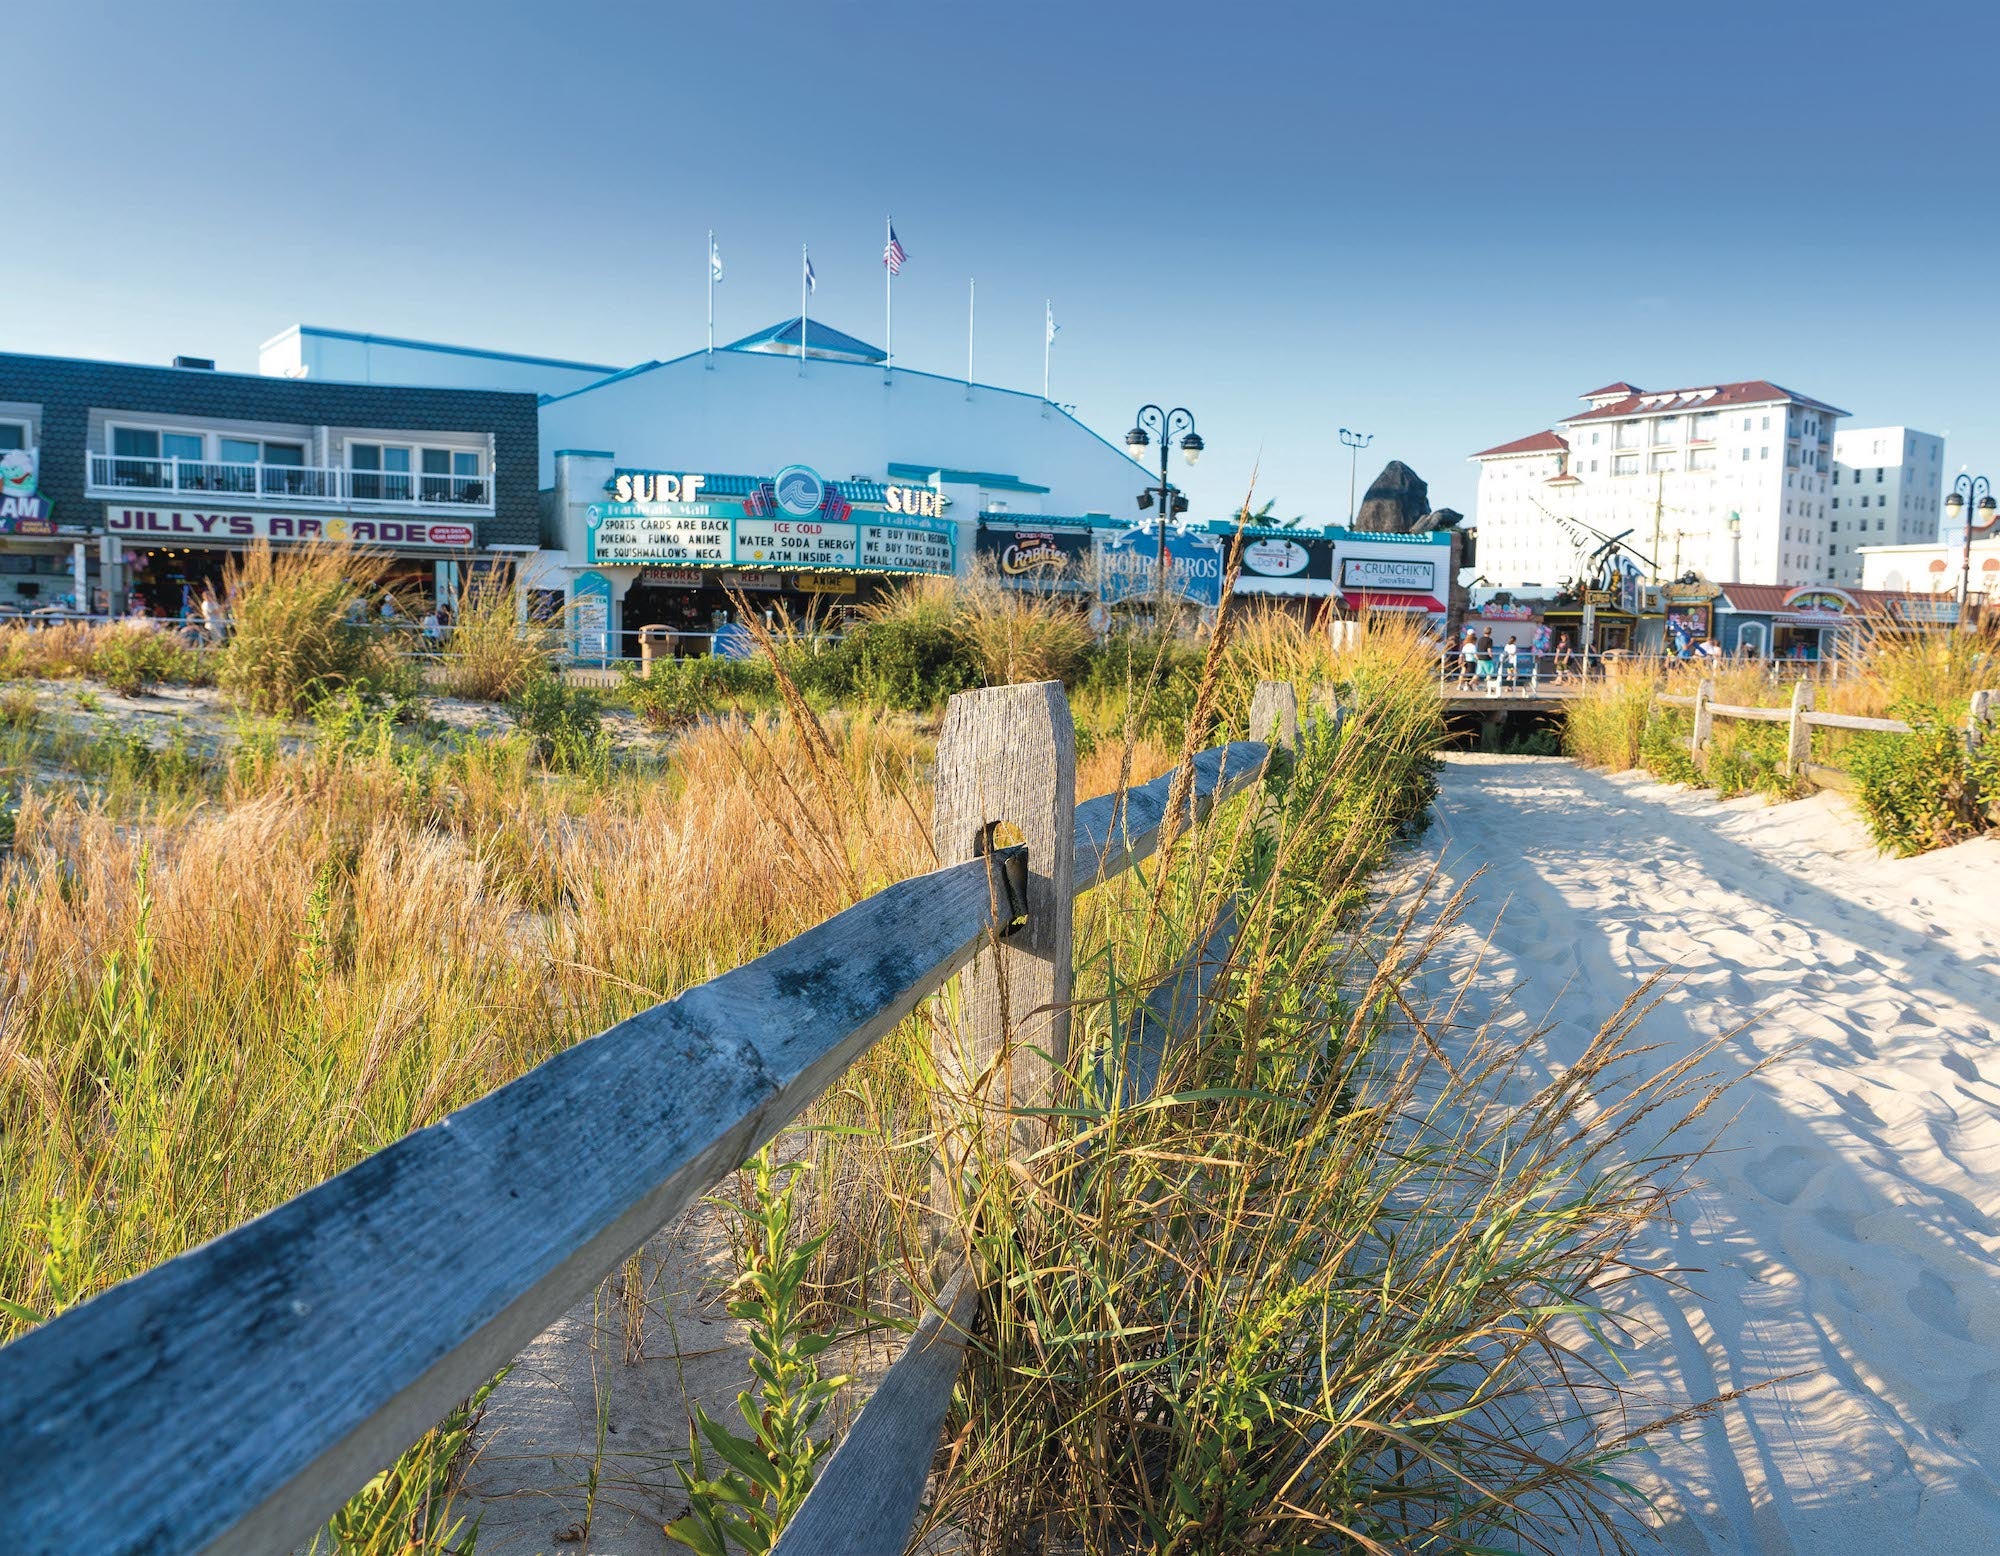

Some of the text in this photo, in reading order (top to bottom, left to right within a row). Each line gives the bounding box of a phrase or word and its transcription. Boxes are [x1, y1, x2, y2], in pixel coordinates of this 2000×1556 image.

[614, 474, 705, 503] SURF
[884, 486, 945, 518] SURF
[110, 510, 255, 535] JILLY'S
[605, 519, 729, 531] SPORTS CARDS ARE BACK
[774, 523, 823, 534] ICE COLD
[600, 534, 721, 545] POKEMON FUNKO ANIME
[869, 528, 882, 538] WE
[887, 529, 904, 540] BUY
[906, 531, 927, 543] VINYL
[739, 535, 856, 550] WATER SODA ENERGY
[866, 541, 879, 551] WE
[885, 542, 902, 554] BUY
[905, 544, 923, 555] TOYS
[695, 549, 722, 559] NECA
[769, 551, 832, 563] ATM INSIDE
[863, 555, 892, 566] EMAIL:
[1174, 558, 1218, 578] BROS
[644, 569, 700, 580] FIREWORKS
[741, 573, 766, 582] RENT
[813, 576, 841, 586] ANIME
